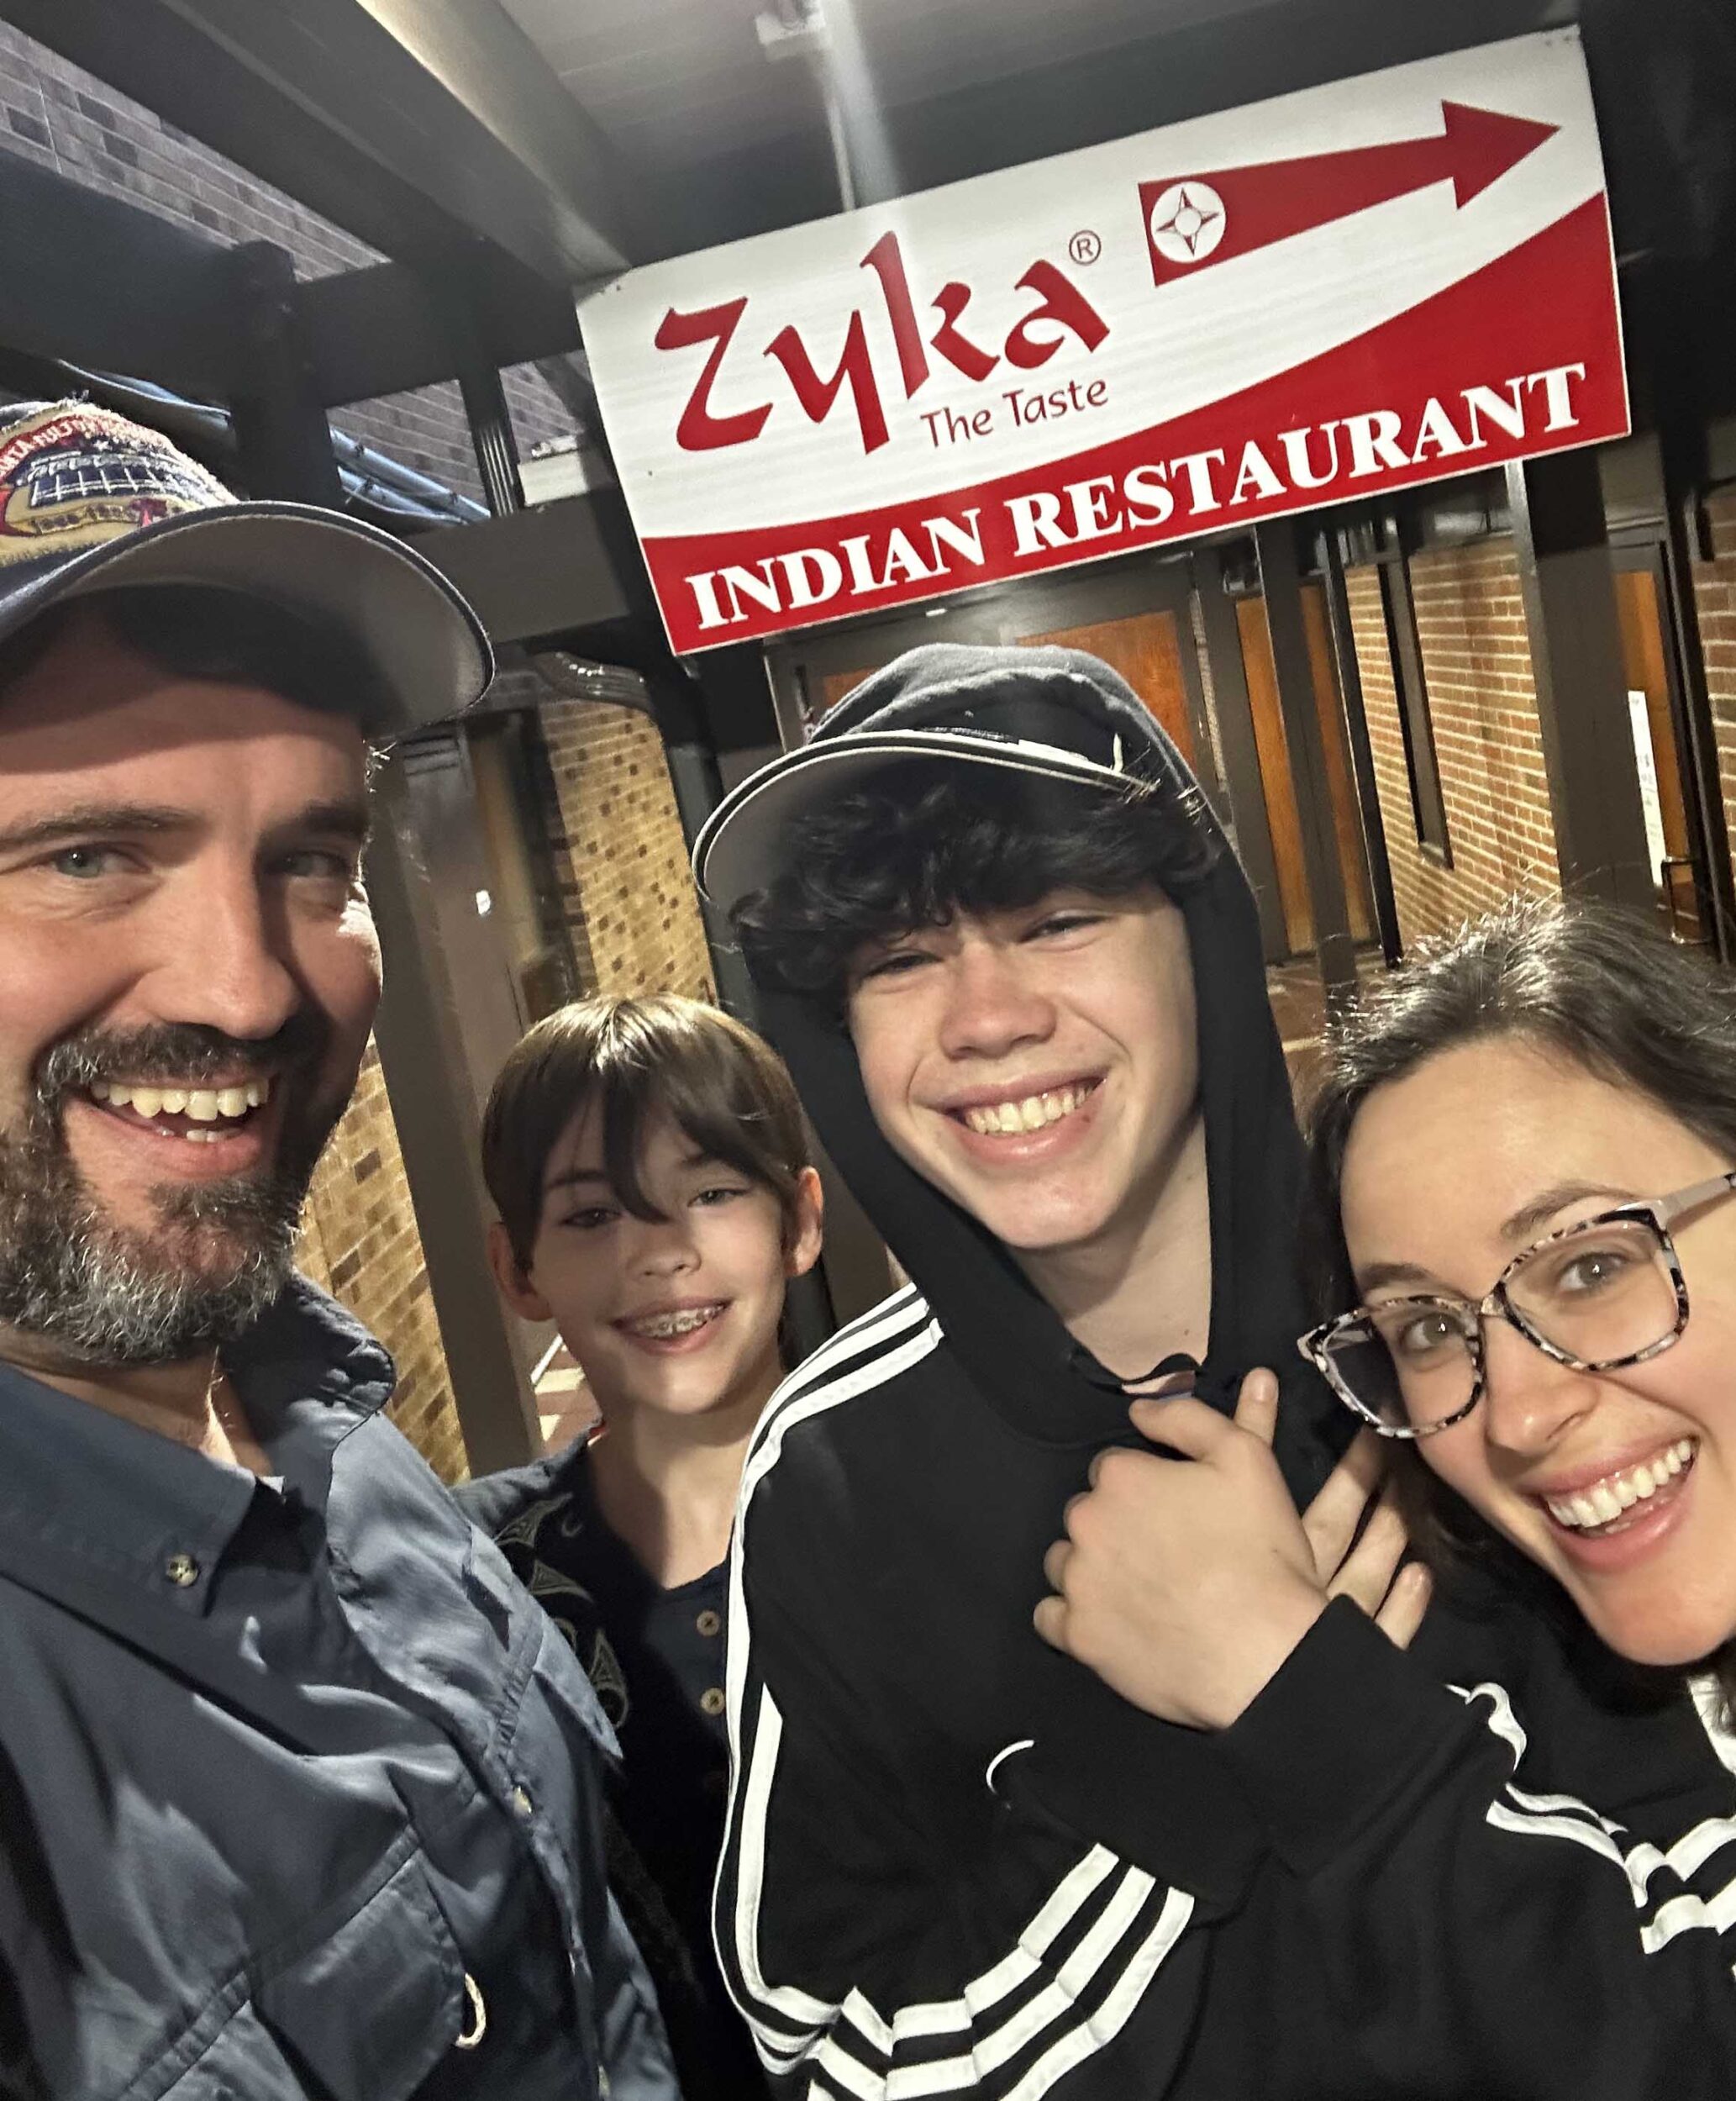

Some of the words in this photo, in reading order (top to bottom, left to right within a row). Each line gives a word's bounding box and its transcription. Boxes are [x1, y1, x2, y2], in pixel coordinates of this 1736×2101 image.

[655, 230, 1109, 455] Zyka
[920, 407, 993, 448] The
[1002, 380, 1108, 427] Taste
[686, 509, 985, 630] INDIAN
[1004, 363, 1586, 557] RESTAURANT
